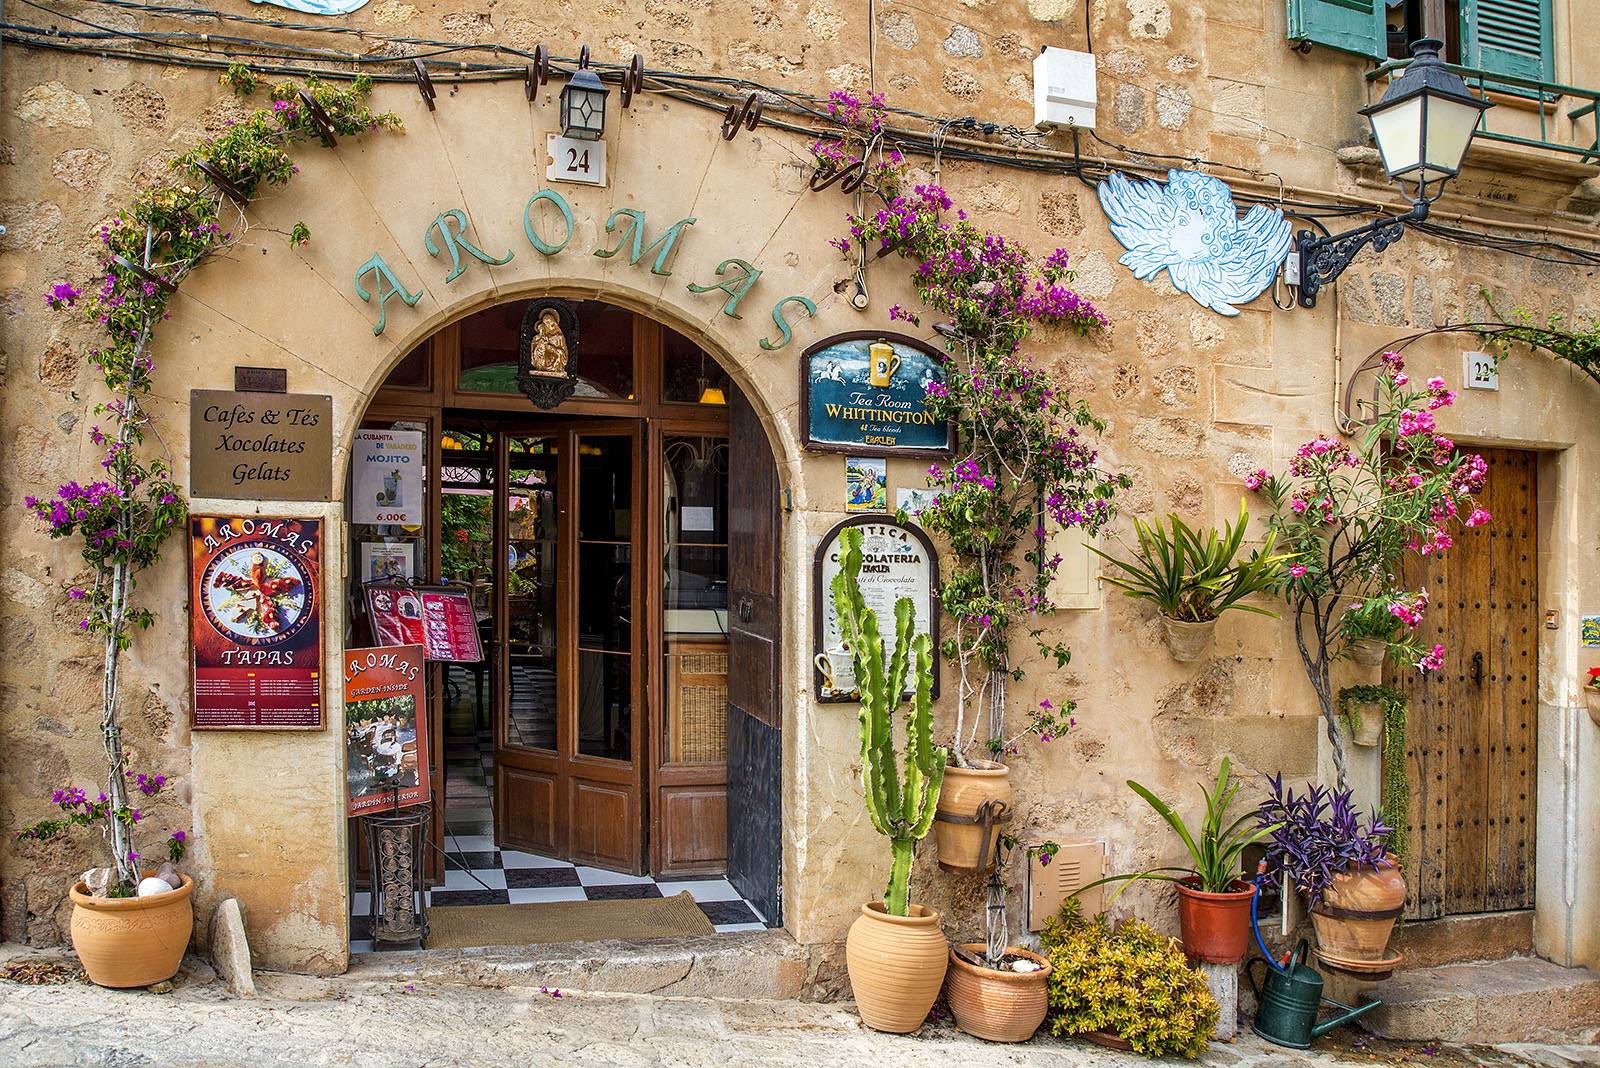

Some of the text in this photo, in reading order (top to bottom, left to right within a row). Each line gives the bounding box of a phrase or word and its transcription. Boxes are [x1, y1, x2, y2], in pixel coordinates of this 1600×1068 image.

[566, 147, 590, 174] 24
[355, 189, 818, 351] AROMAS
[848, 391, 912, 410] Tea Room
[260, 409, 281, 425] &
[824, 403, 936, 425] WHITTINGTON
[362, 433, 394, 441] CUBANITA
[869, 424, 881, 433] Tea
[881, 425, 902, 434] blends
[214, 433, 306, 454] Xocolates
[366, 454, 411, 464] MOJITO
[231, 461, 292, 486] Gelats
[376, 513, 408, 522] 6.00€
[203, 518, 314, 555] AROMAS
[220, 646, 295, 666] TAPAS
[351, 682, 409, 698] GARDEN INSIDE
